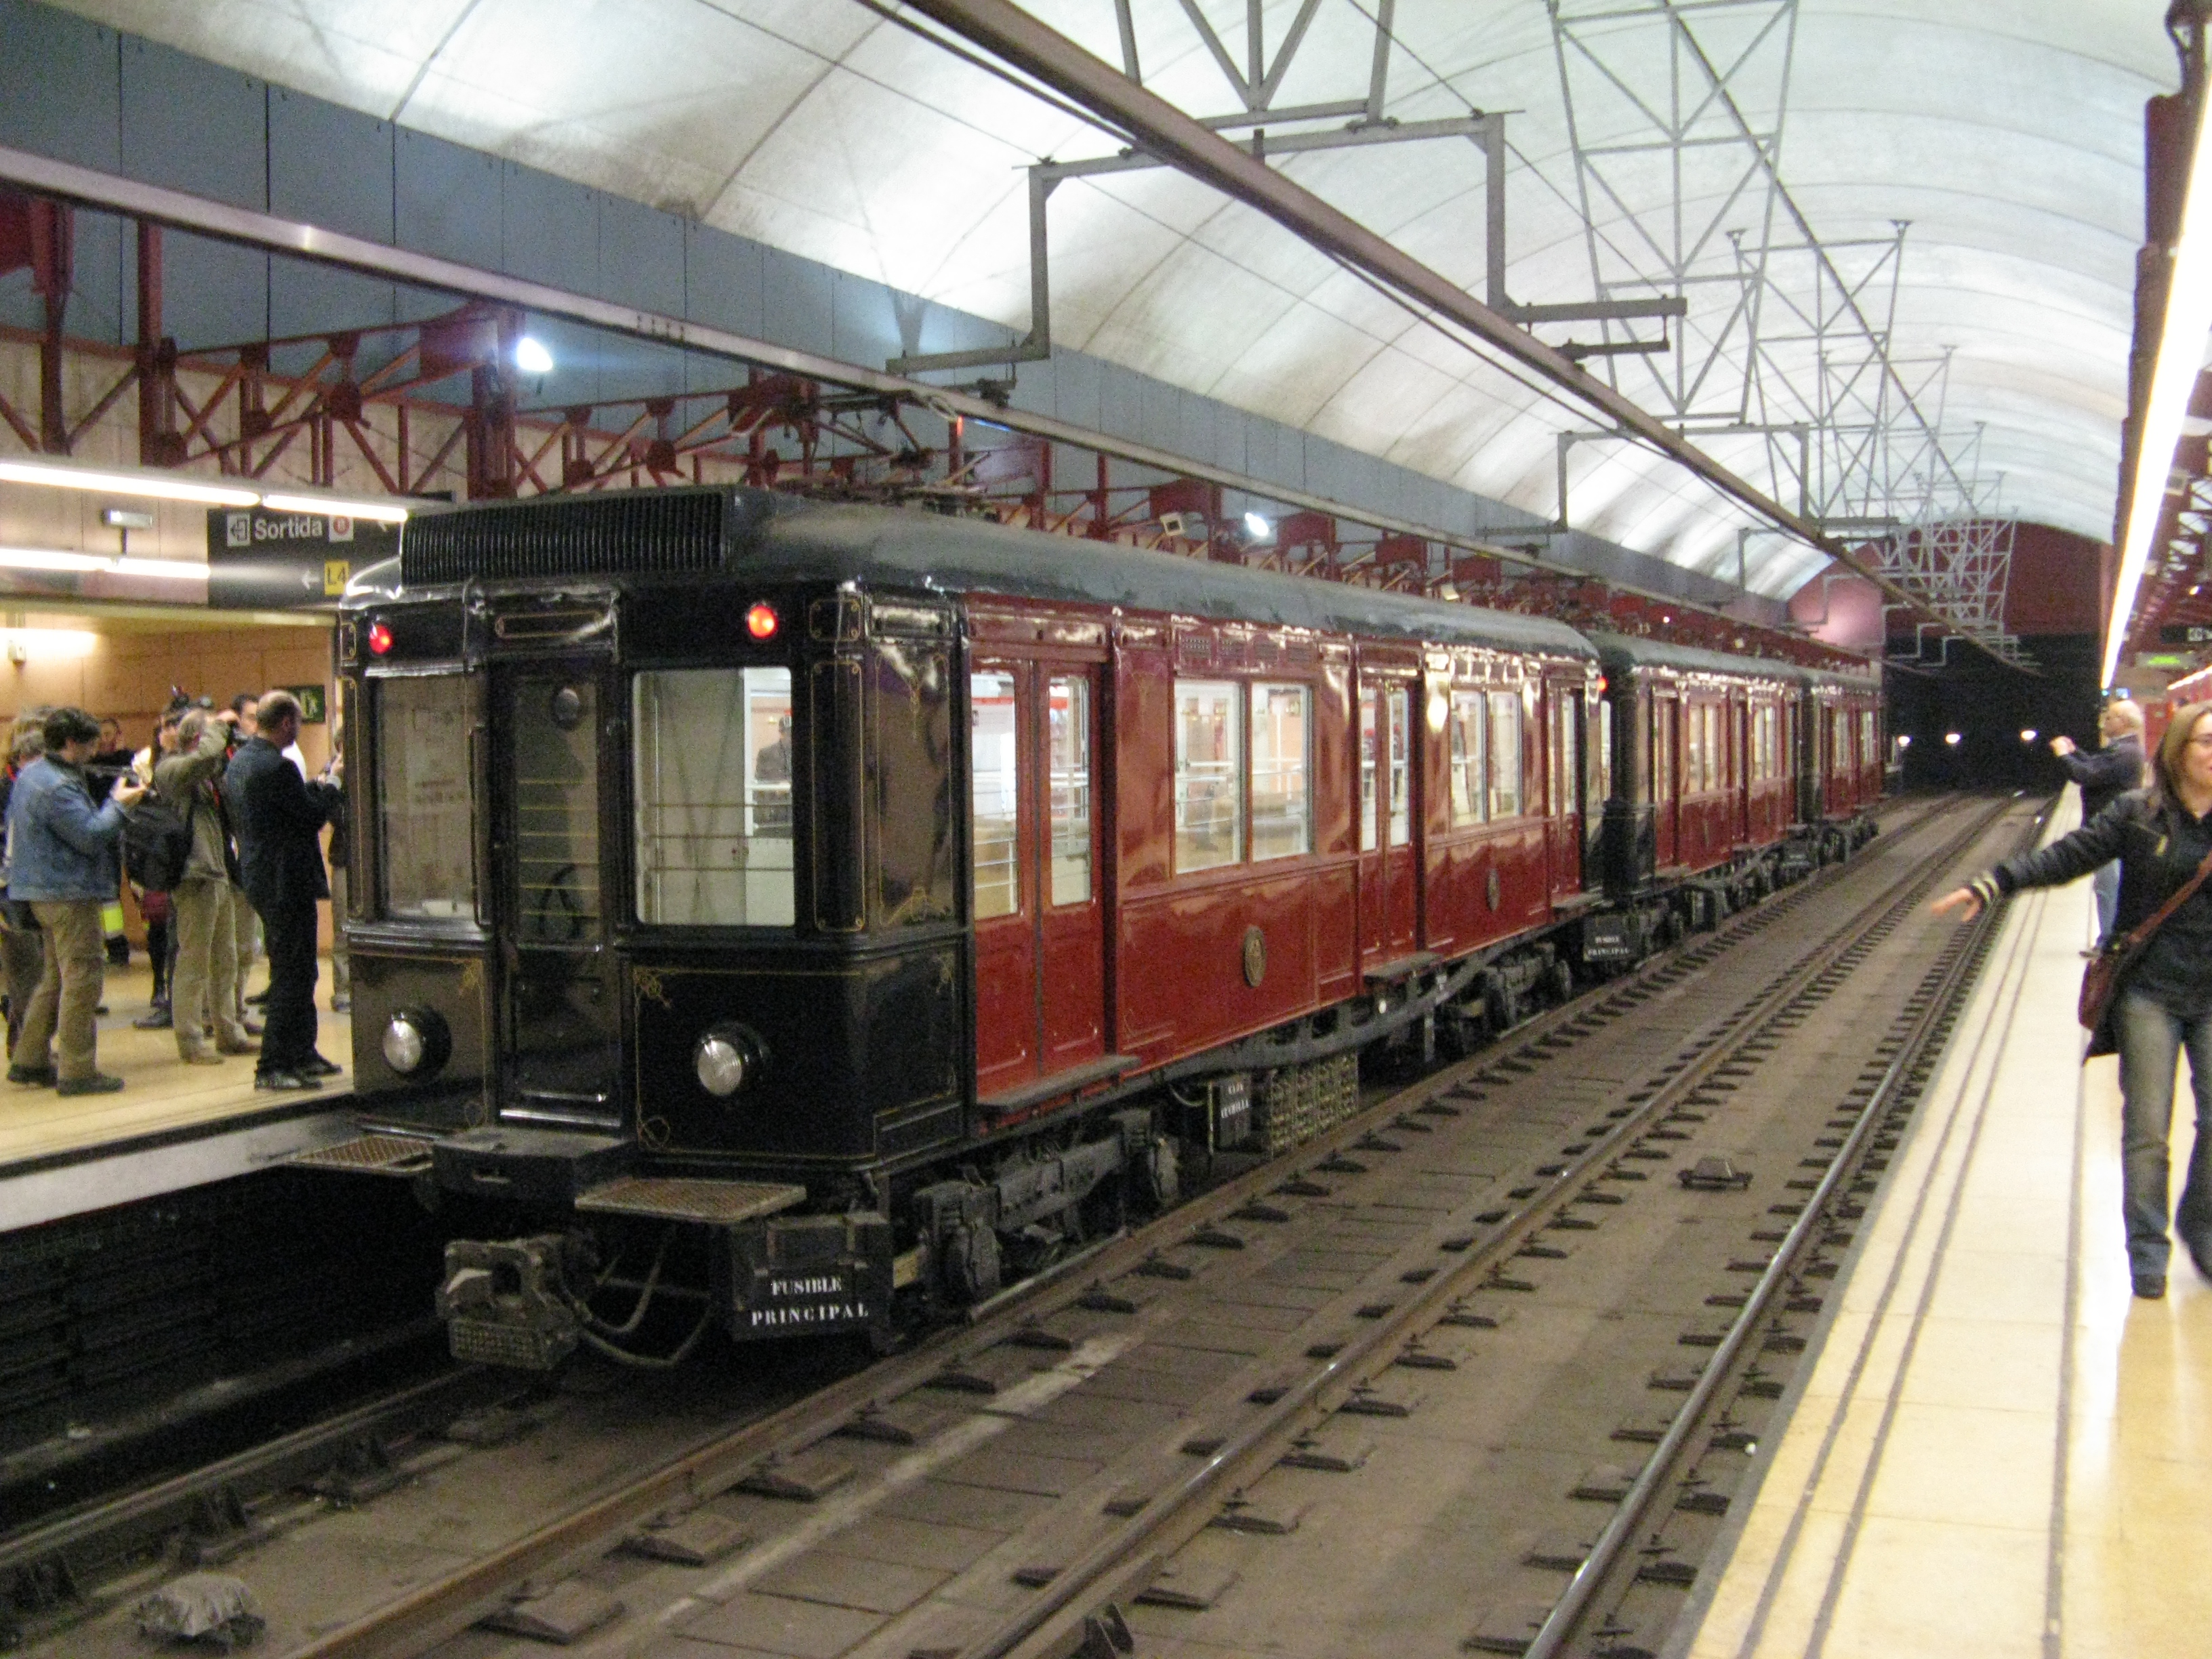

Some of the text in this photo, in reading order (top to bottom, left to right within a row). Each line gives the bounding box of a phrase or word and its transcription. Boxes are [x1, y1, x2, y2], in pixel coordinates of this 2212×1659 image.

[254, 516, 323, 540] Sortida
[327, 566, 346, 585] L4
[771, 1275, 842, 1296] FUSIBLE
[752, 1302, 869, 1326] PRINCIPAL
